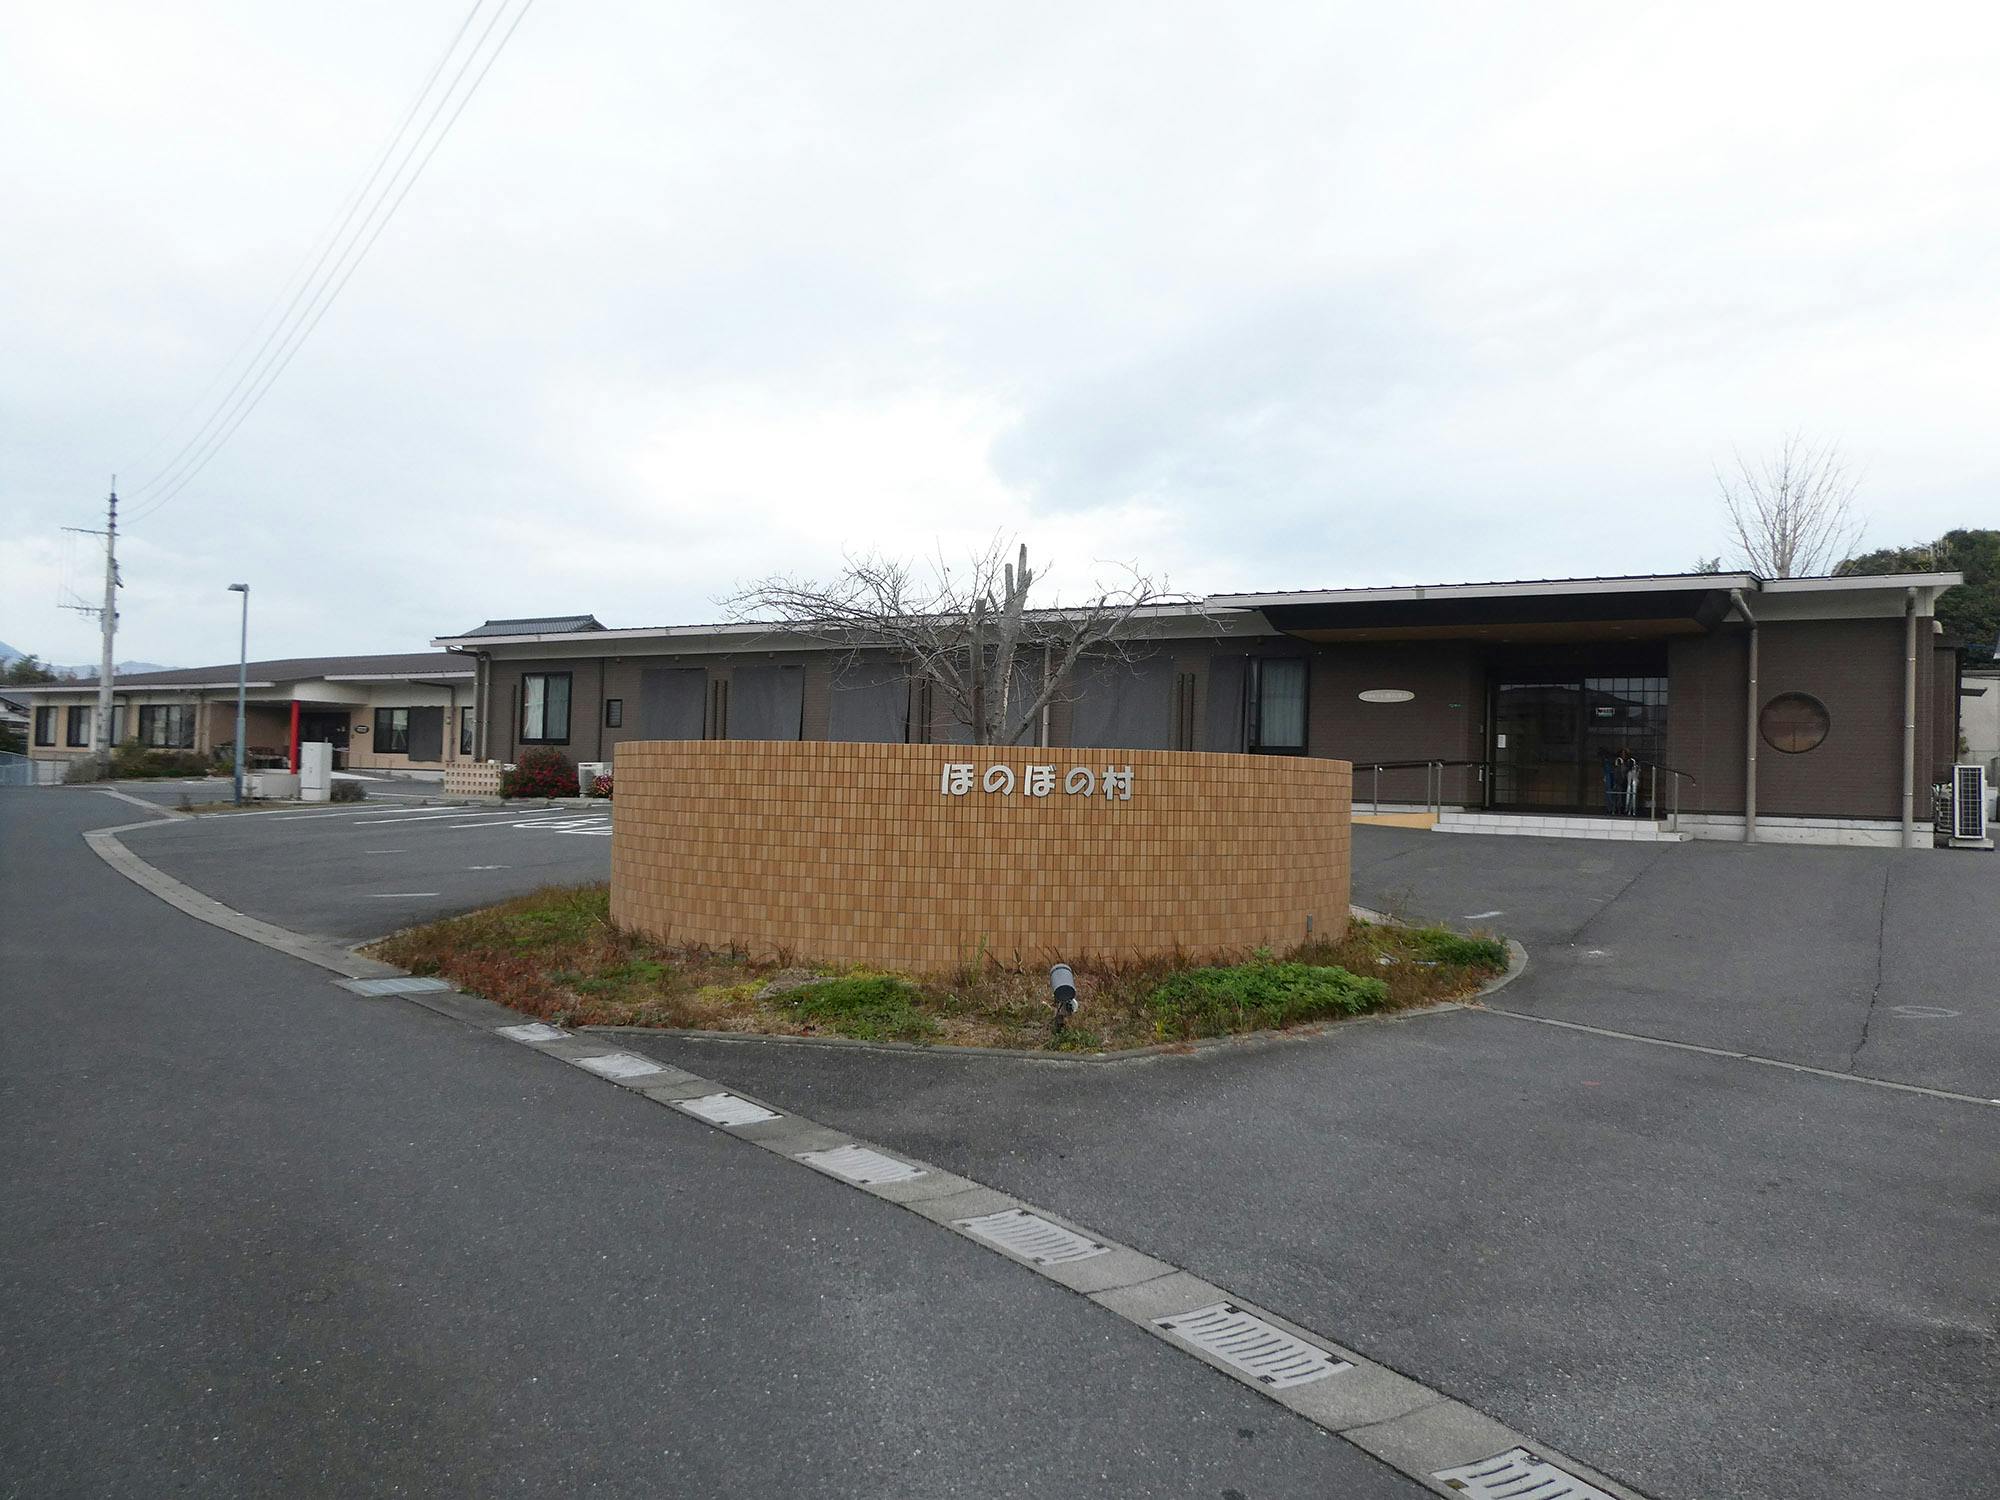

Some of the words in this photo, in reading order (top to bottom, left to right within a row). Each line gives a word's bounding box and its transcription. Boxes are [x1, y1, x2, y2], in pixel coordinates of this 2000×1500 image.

[941, 763, 1134, 800] ほのぼの村
